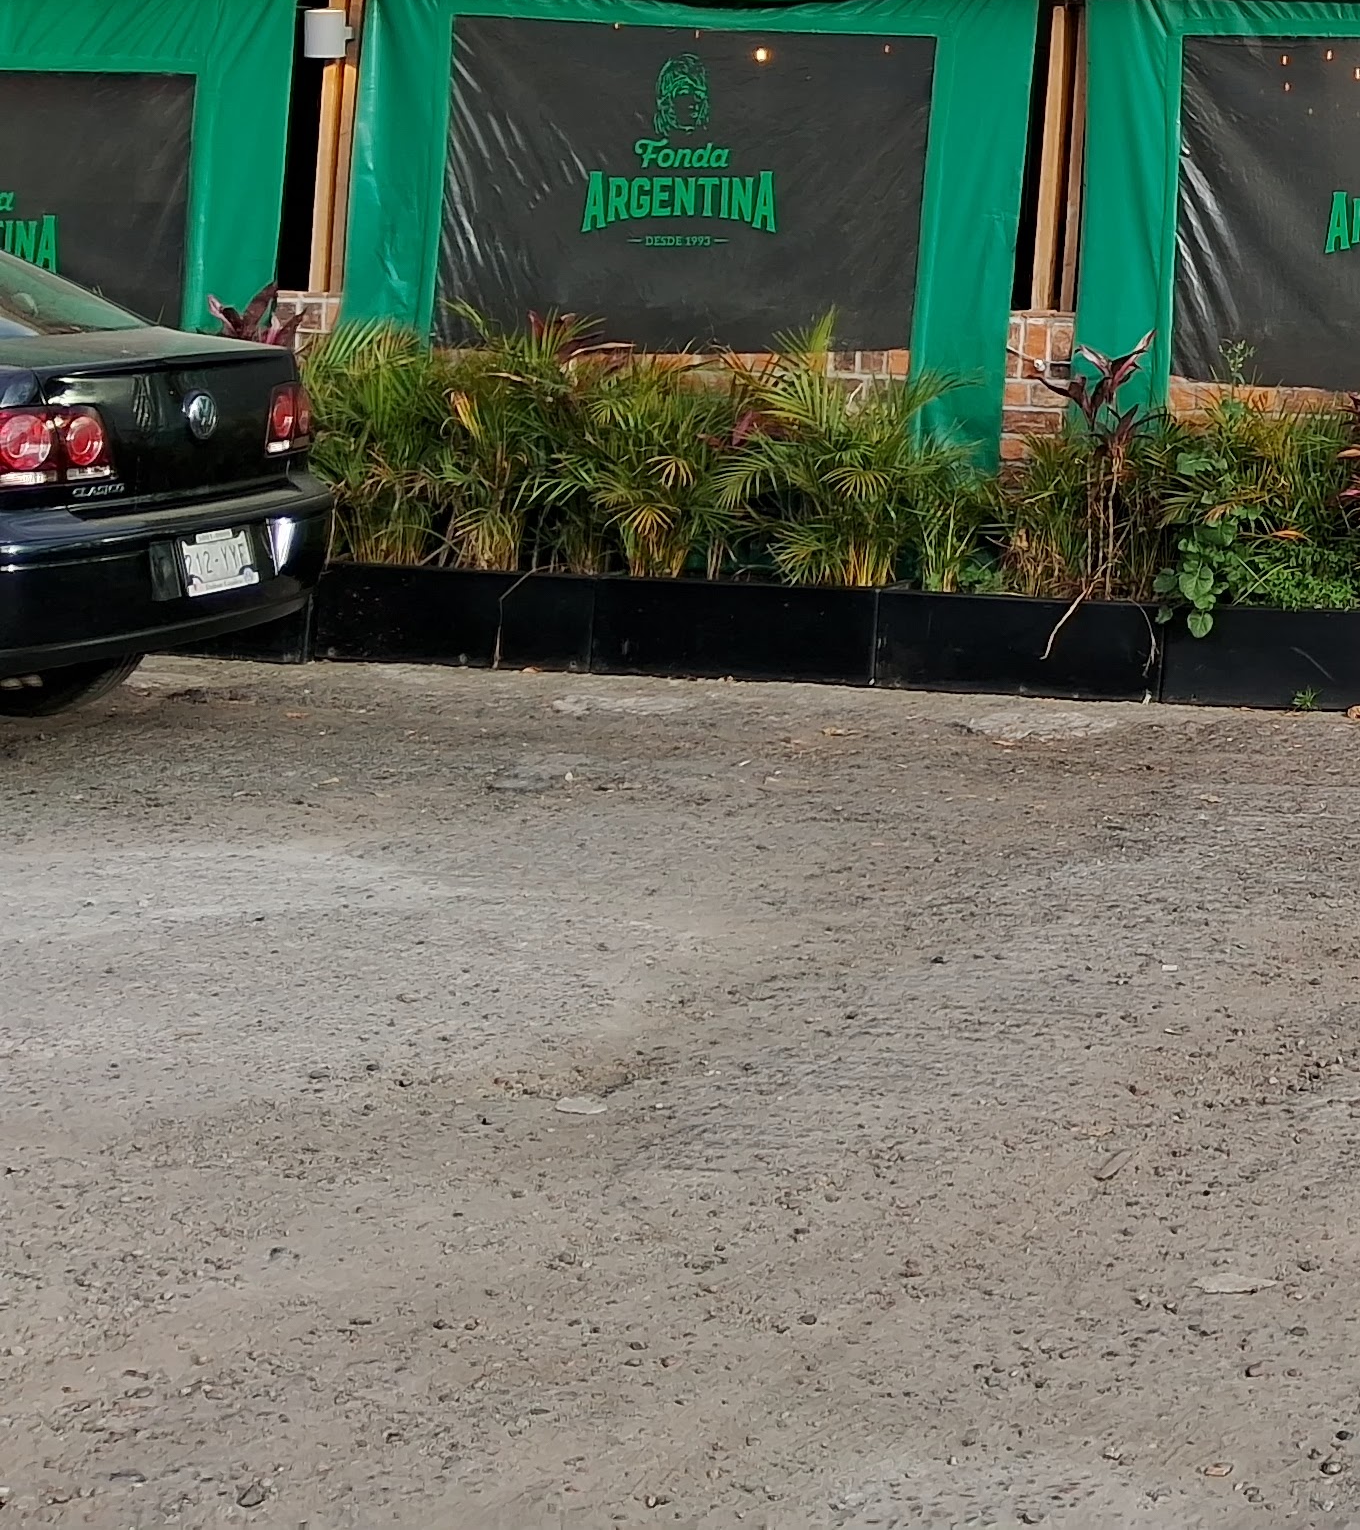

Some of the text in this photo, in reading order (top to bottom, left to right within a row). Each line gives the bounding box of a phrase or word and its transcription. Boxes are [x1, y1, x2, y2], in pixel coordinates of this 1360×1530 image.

[635, 138, 730, 167] Fonda
[581, 171, 776, 233] ARGENTINA
[645, 236, 711, 246] DESDE 1993
